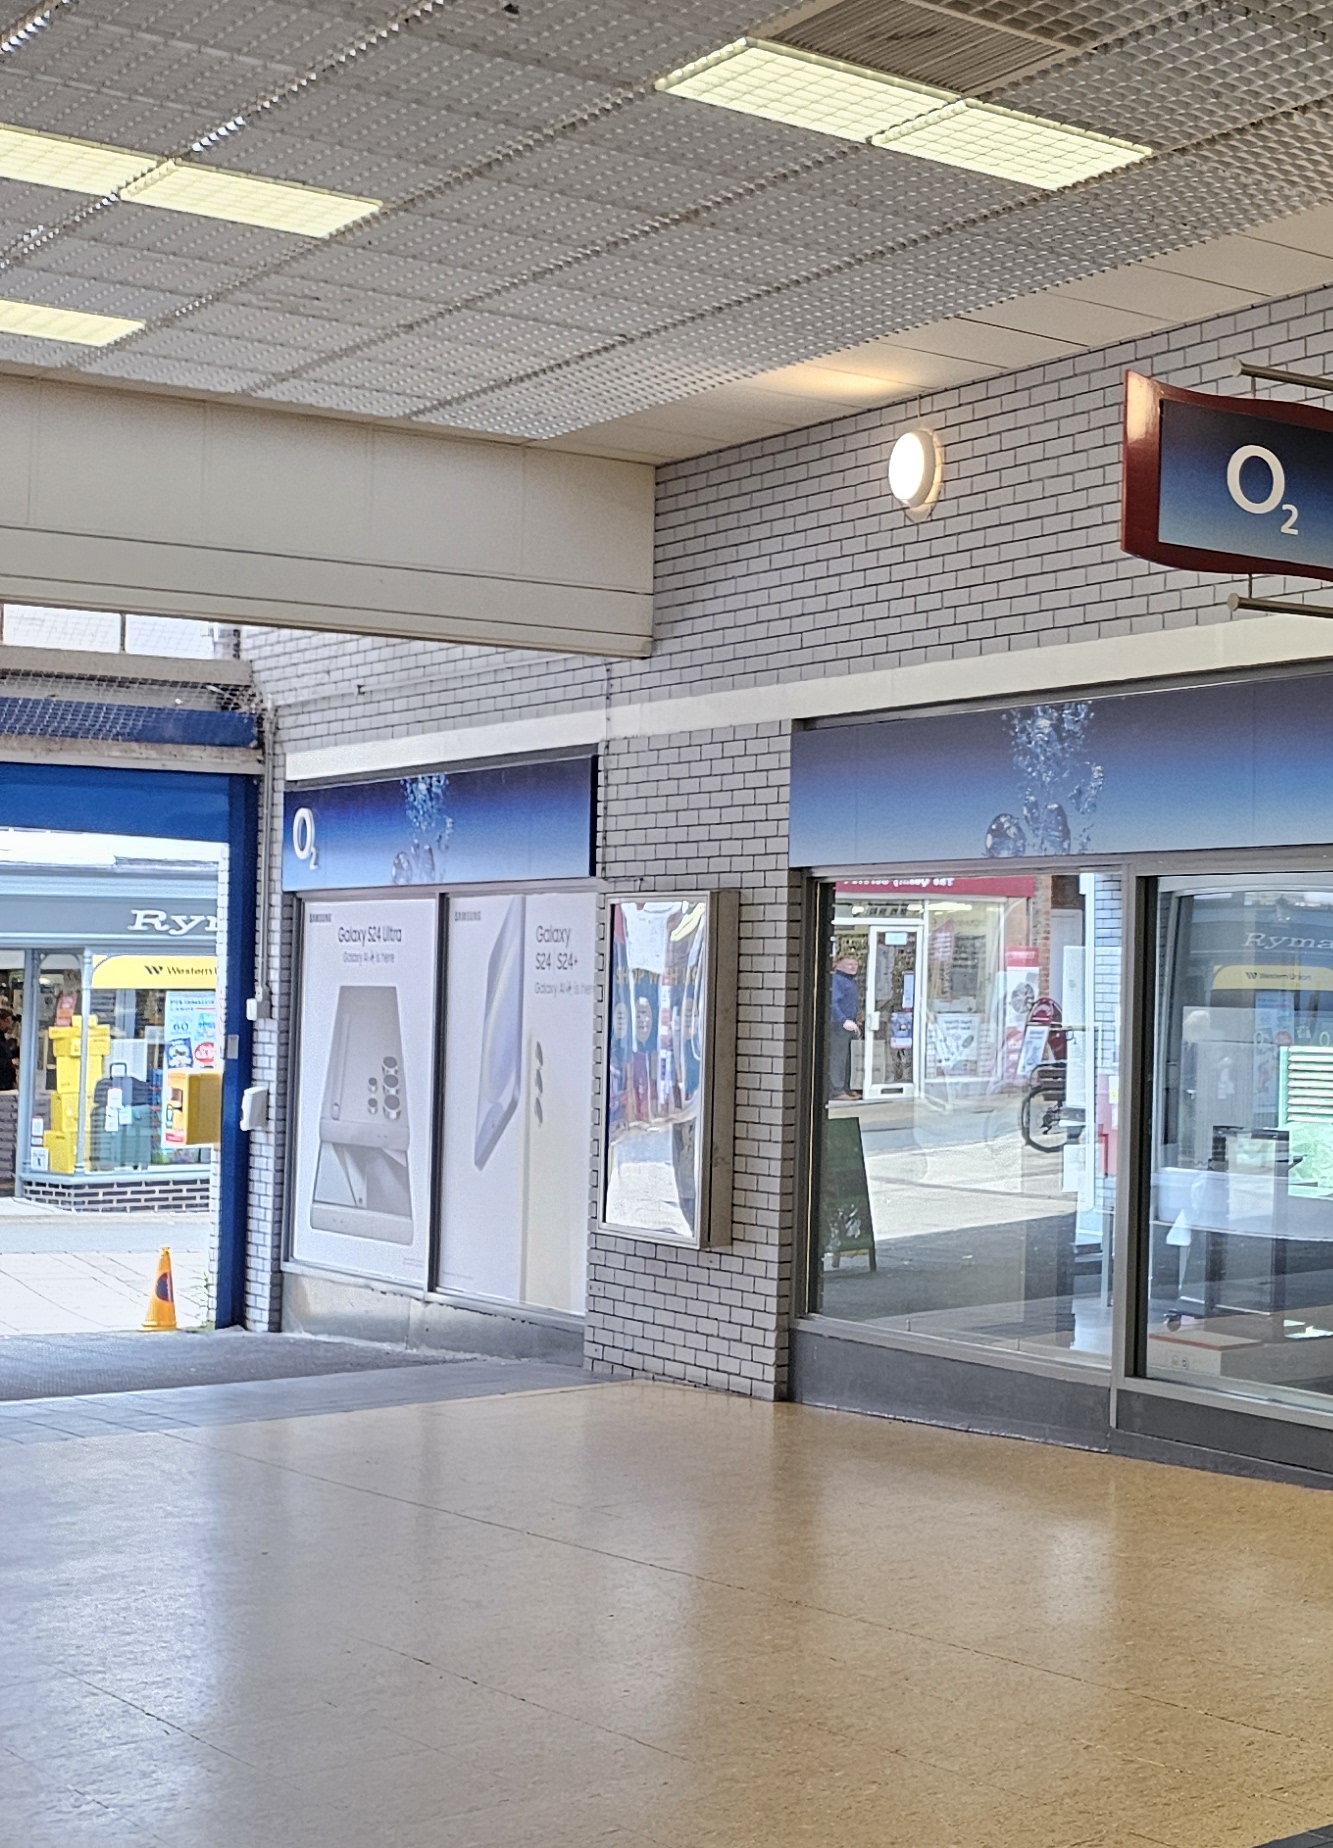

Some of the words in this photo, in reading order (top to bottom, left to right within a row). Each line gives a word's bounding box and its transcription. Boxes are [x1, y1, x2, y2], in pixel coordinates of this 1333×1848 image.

[338, 926, 367, 946] Galaxy
[368, 926, 382, 943] S24
[382, 926, 402, 943] Ultra
[536, 925, 571, 948] Galaxy
[535, 953, 551, 970] S24
[557, 952, 578, 970] S24+
